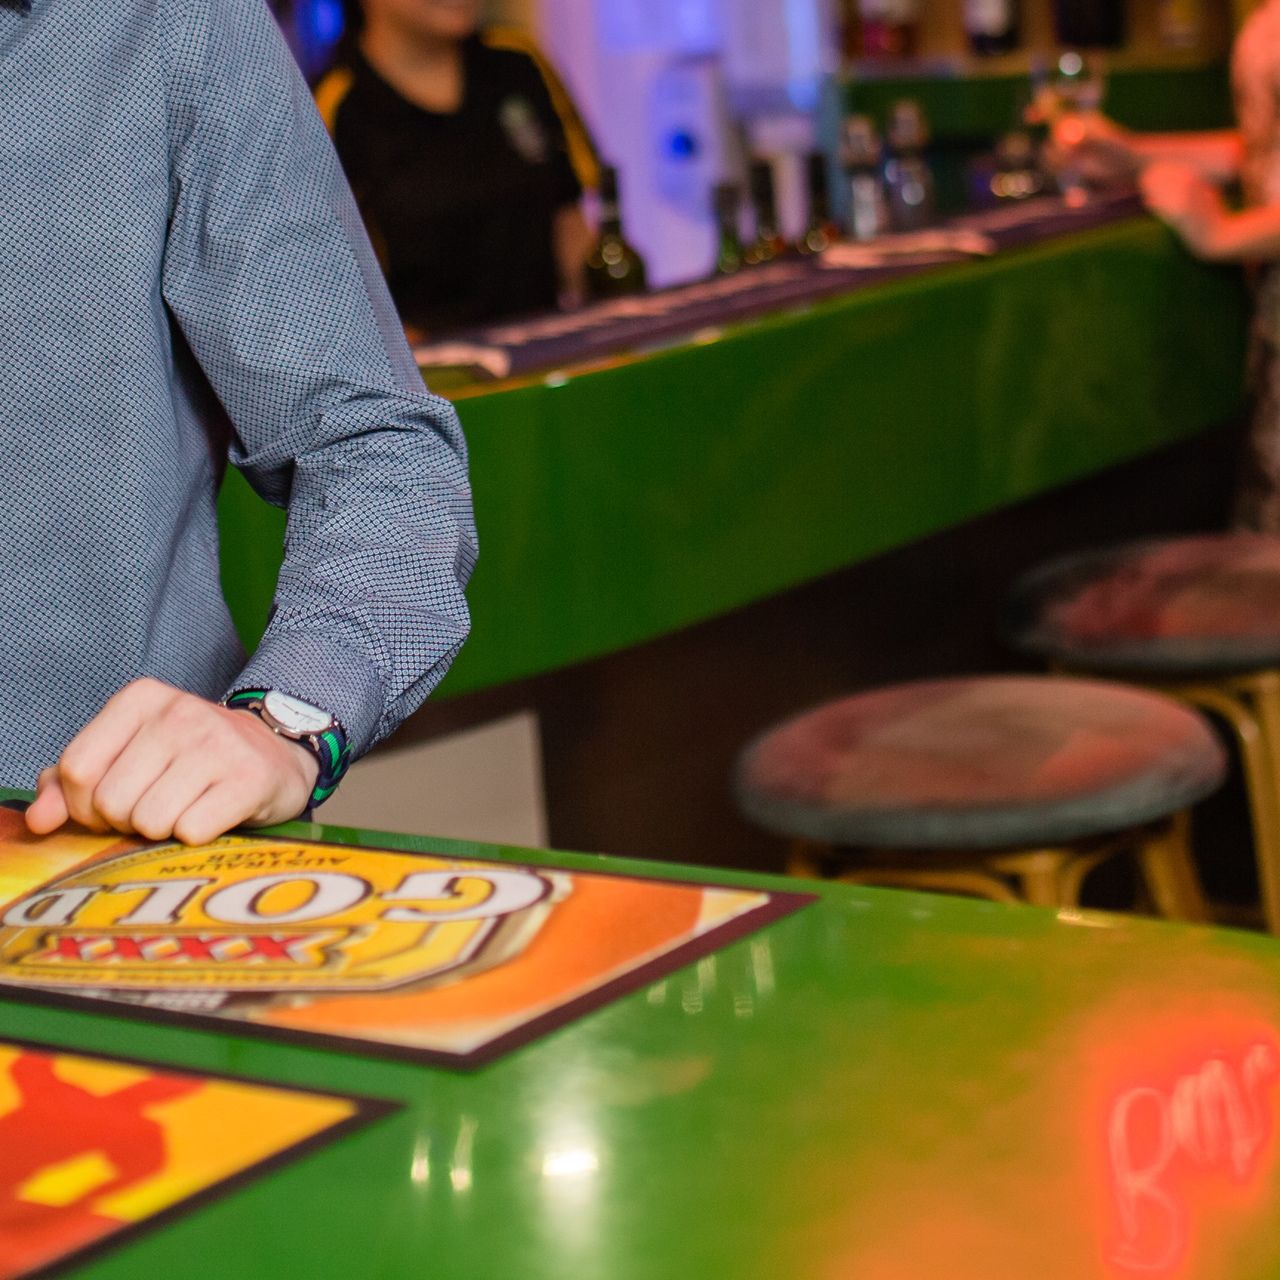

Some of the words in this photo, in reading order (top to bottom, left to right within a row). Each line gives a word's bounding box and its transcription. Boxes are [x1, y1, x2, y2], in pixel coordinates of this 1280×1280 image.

[158, 855, 353, 874] AUSTRALIAN
[206, 849, 307, 863] LAGER
[3, 869, 553, 927] GOLD
[47, 934, 314, 965] XXXX
